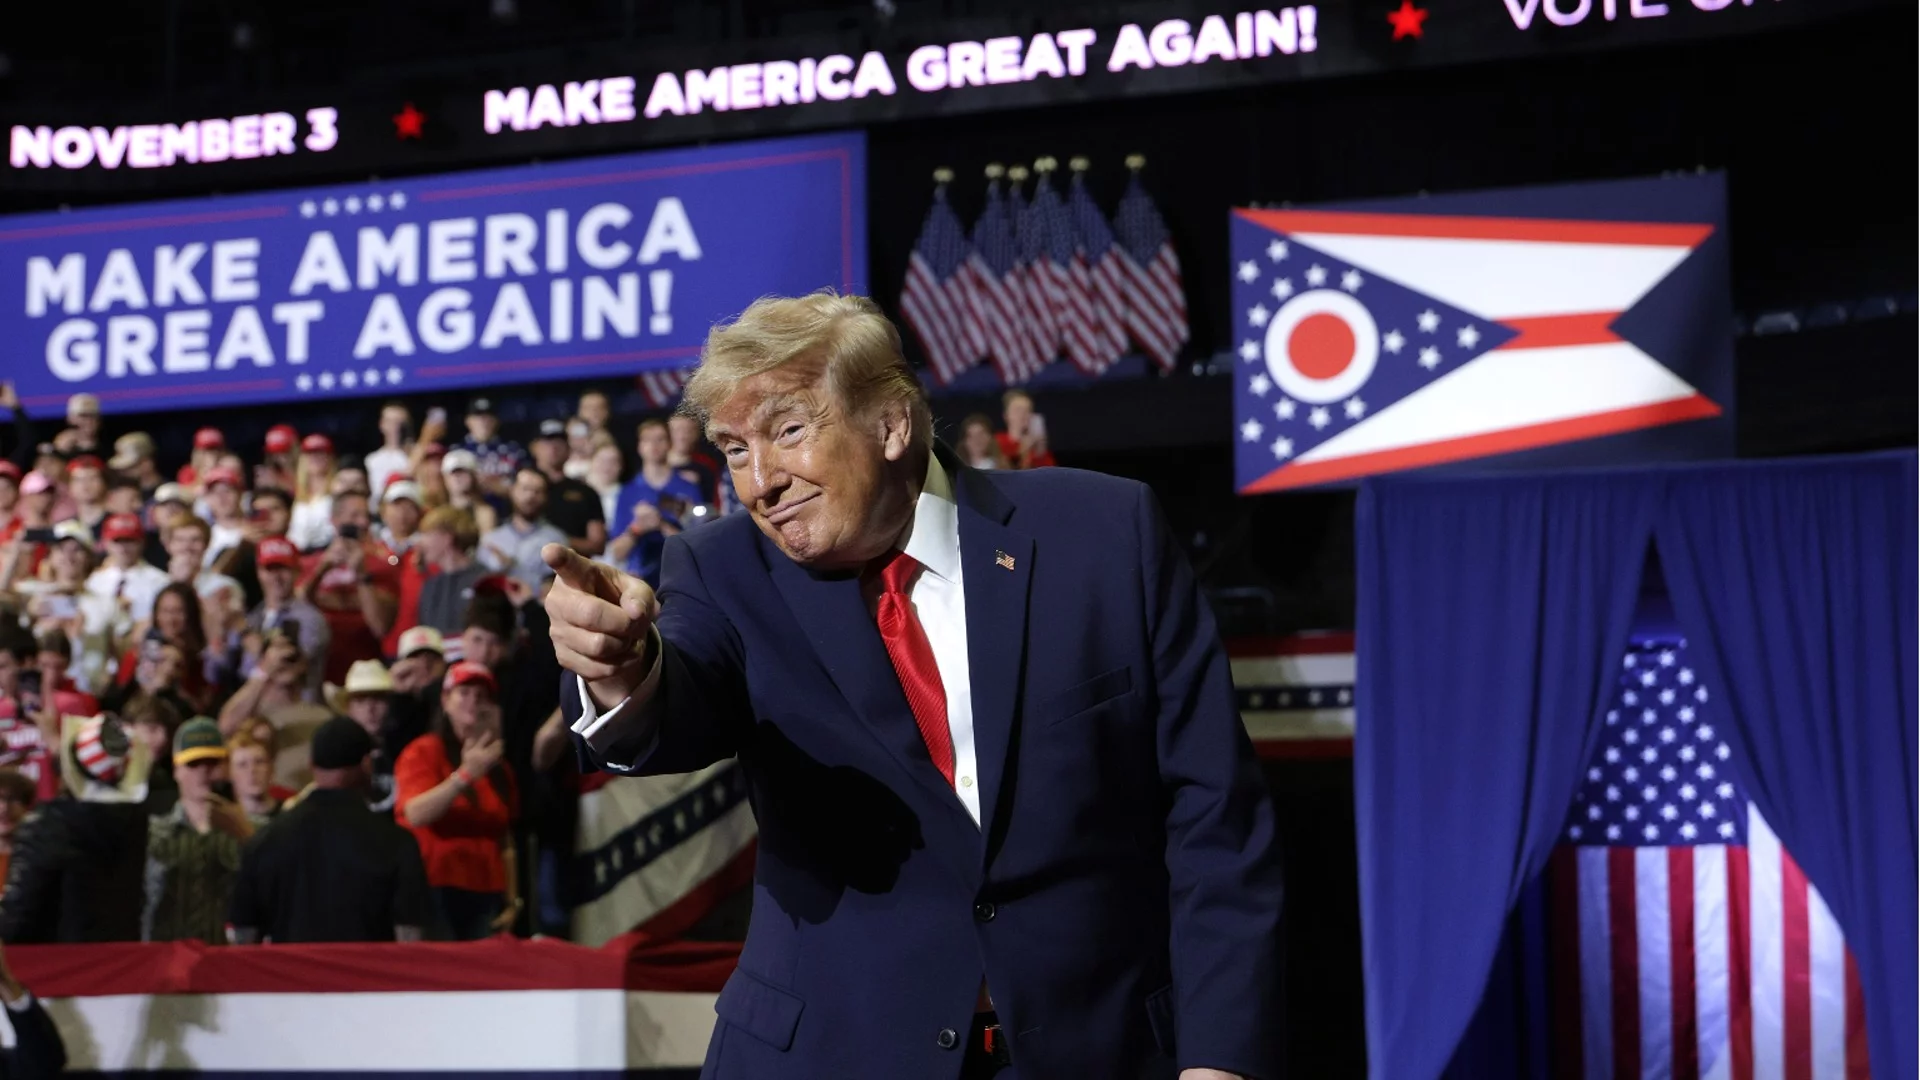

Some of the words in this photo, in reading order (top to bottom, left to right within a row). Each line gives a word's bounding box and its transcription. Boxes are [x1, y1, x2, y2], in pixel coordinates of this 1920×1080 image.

[484, 76, 636, 134] MAKE
[644, 51, 897, 118] AMERICA
[906, 28, 1097, 92] GREAT
[1107, 5, 1318, 72] AGAIN!
[10, 112, 297, 169] NOVEMBER
[305, 107, 338, 151] 3
[25, 237, 261, 318] MAKE
[289, 196, 702, 296] AMERICA
[45, 299, 325, 382] GREAT
[352, 269, 673, 359] AGAIN!
